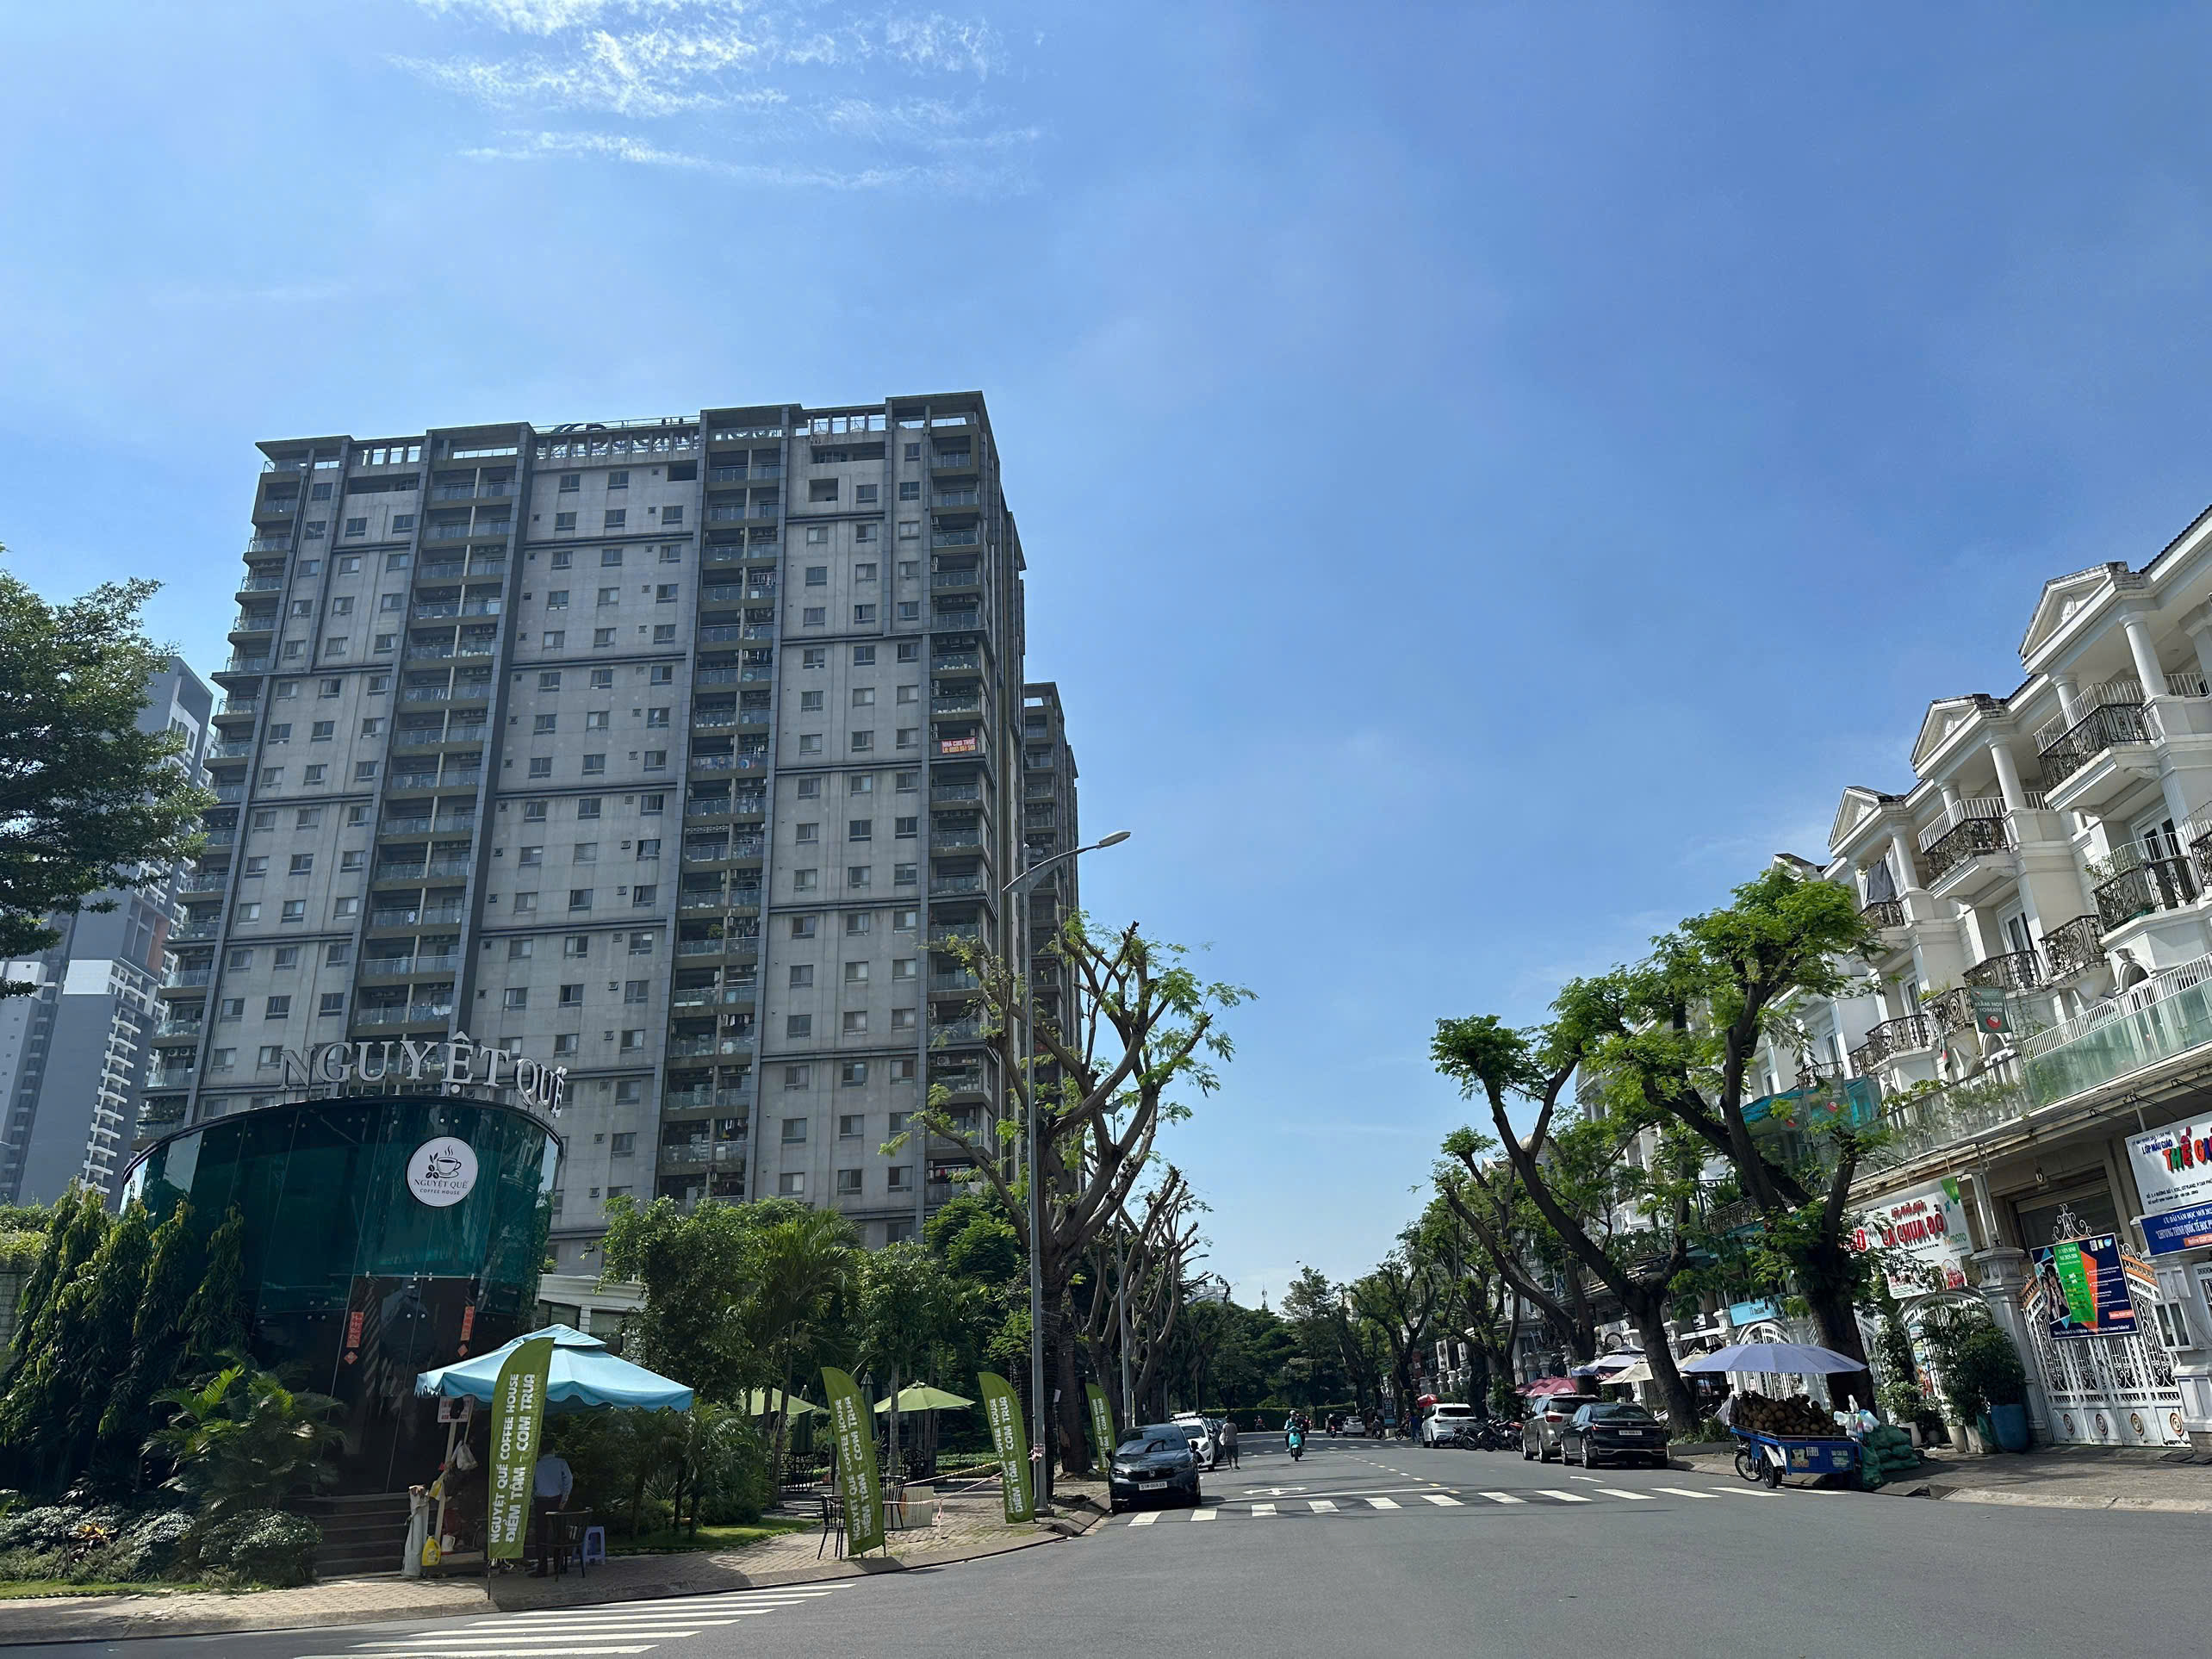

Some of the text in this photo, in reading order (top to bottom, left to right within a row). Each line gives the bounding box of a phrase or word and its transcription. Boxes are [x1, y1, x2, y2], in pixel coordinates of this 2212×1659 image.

[280, 1030, 510, 1094] NGUYỆT
[515, 1057, 568, 1117] QUẾ
[2161, 1137, 2173, 1149] GIÁO
[2162, 1126, 2212, 1172] THẾ GI
[413, 1178, 469, 1189] NGUYỆT QUẾ
[1896, 1219, 1926, 1242] CHUA
[1926, 1203, 1944, 1235] ĐỎ
[834, 1399, 848, 1432] HOUSE
[989, 1398, 1000, 1426] HOUSE
[490, 1373, 519, 1544] NGUYỆT QUẾ COFFEE HOUSE
[841, 1434, 853, 1472] COFFEE
[993, 1426, 1004, 1458] COFFEE
[509, 1466, 526, 1501] TÂM
